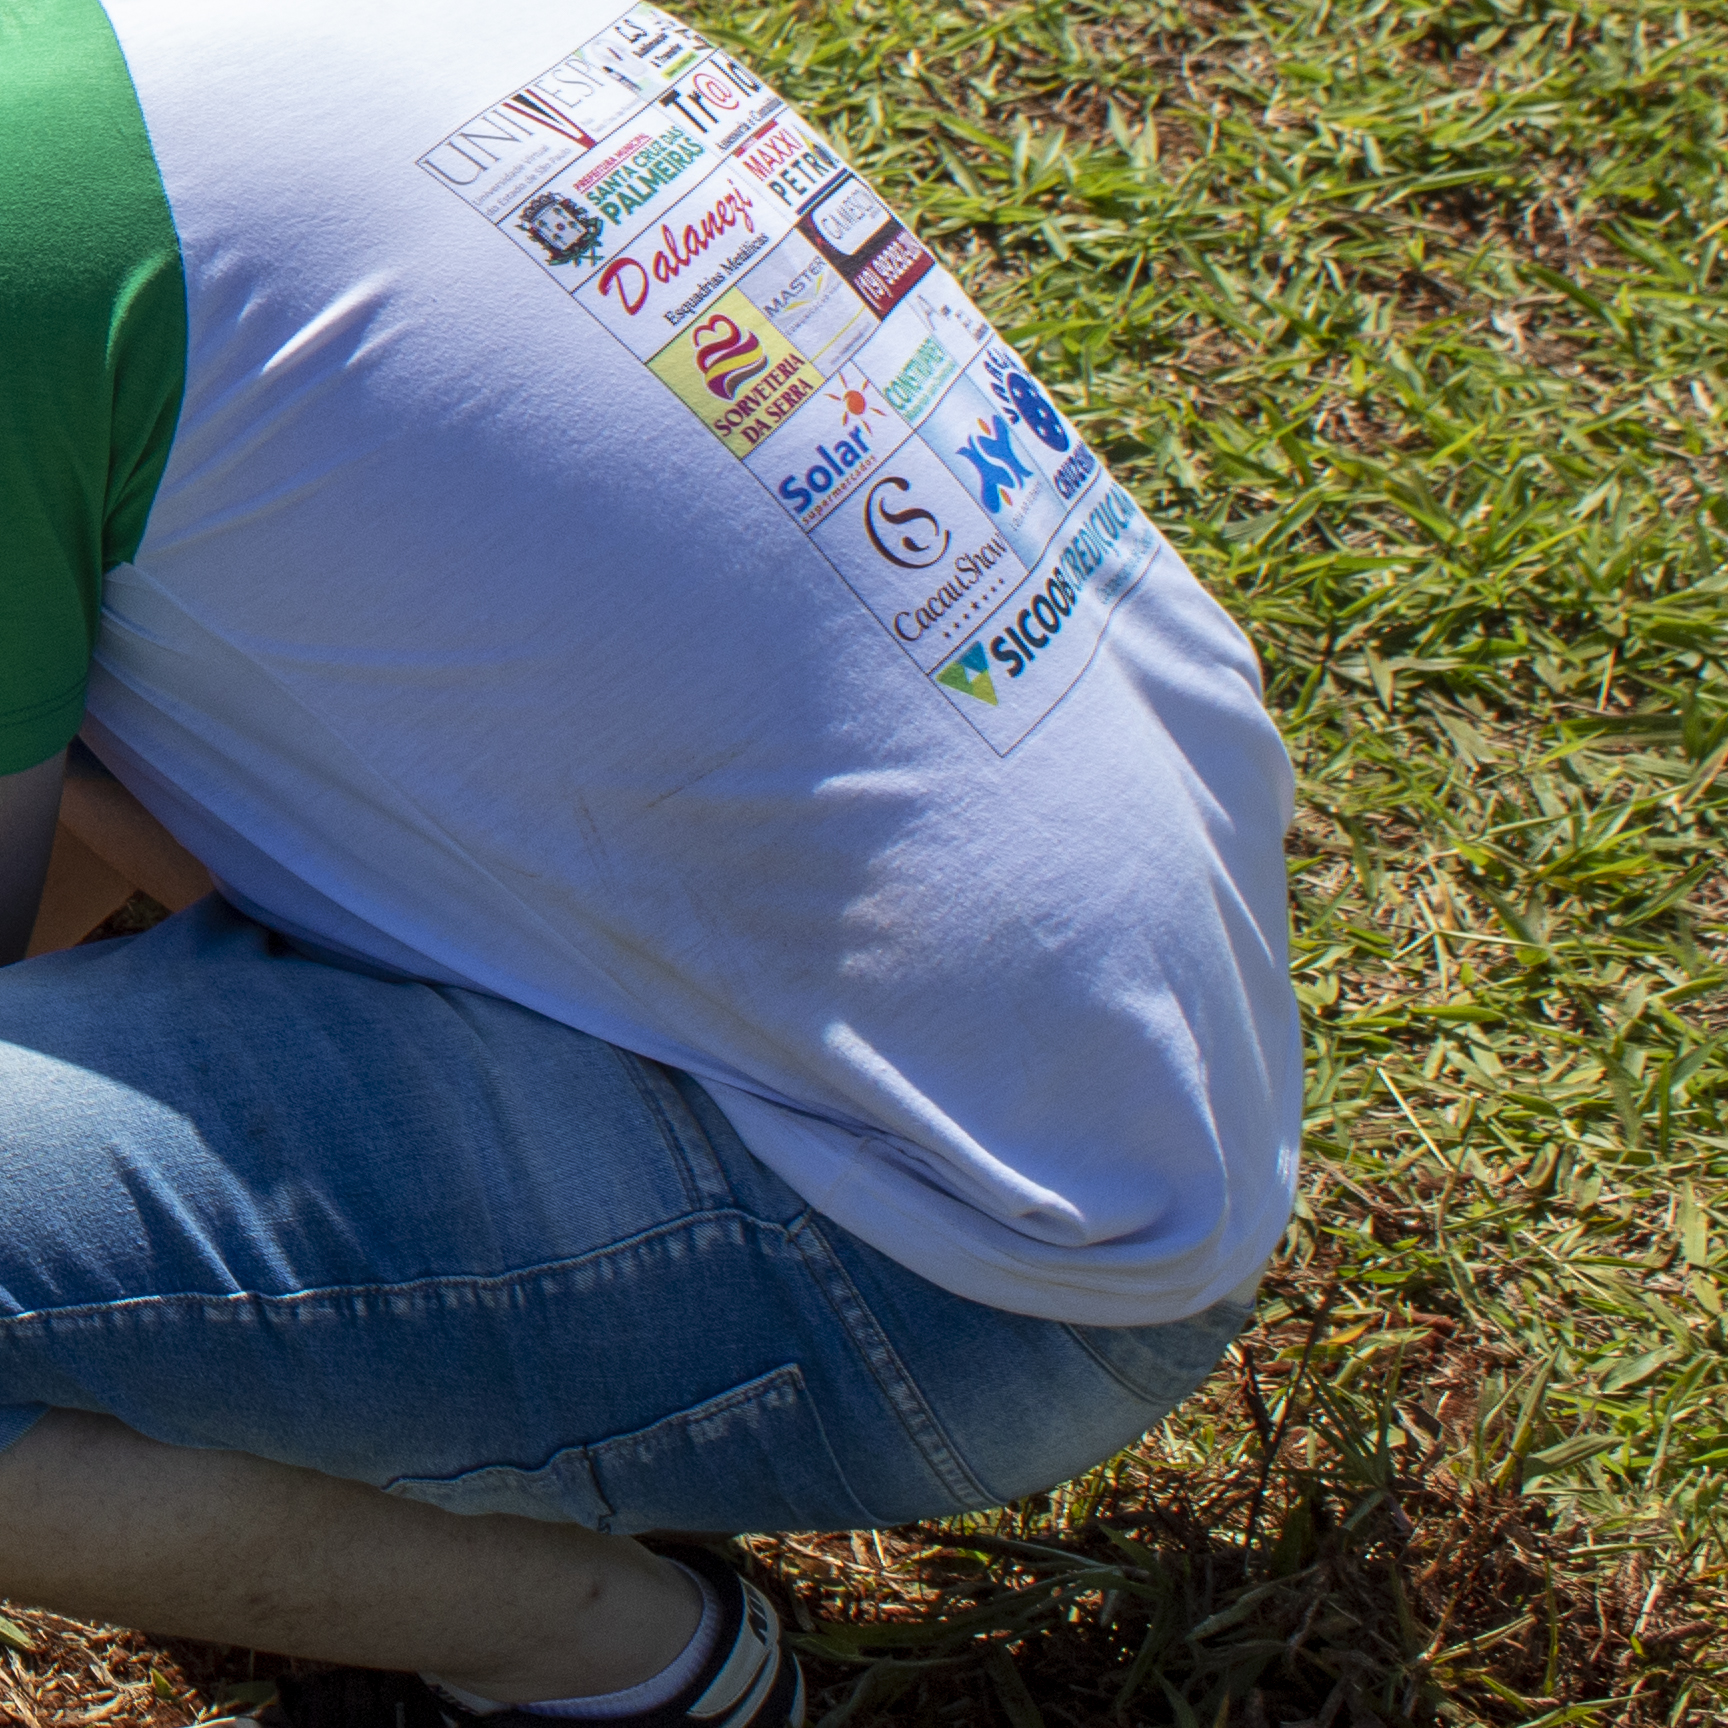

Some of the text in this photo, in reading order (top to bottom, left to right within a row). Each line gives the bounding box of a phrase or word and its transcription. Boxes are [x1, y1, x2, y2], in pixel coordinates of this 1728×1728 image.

[586, 164, 638, 206] SANTA
[631, 140, 665, 169] CRUZ
[599, 136, 705, 226] PALMEIRAS
[743, 127, 804, 182] MAXXI
[598, 178, 754, 316] Dalanezi
[663, 271, 728, 327] Esquadrias
[763, 255, 827, 317] MASTER
[714, 352, 805, 437] SORVETERIA
[741, 377, 814, 445] DA SERRA
[778, 425, 870, 513] Solar
[801, 455, 876, 525] supermercados
[989, 566, 1078, 678] SICOOB
